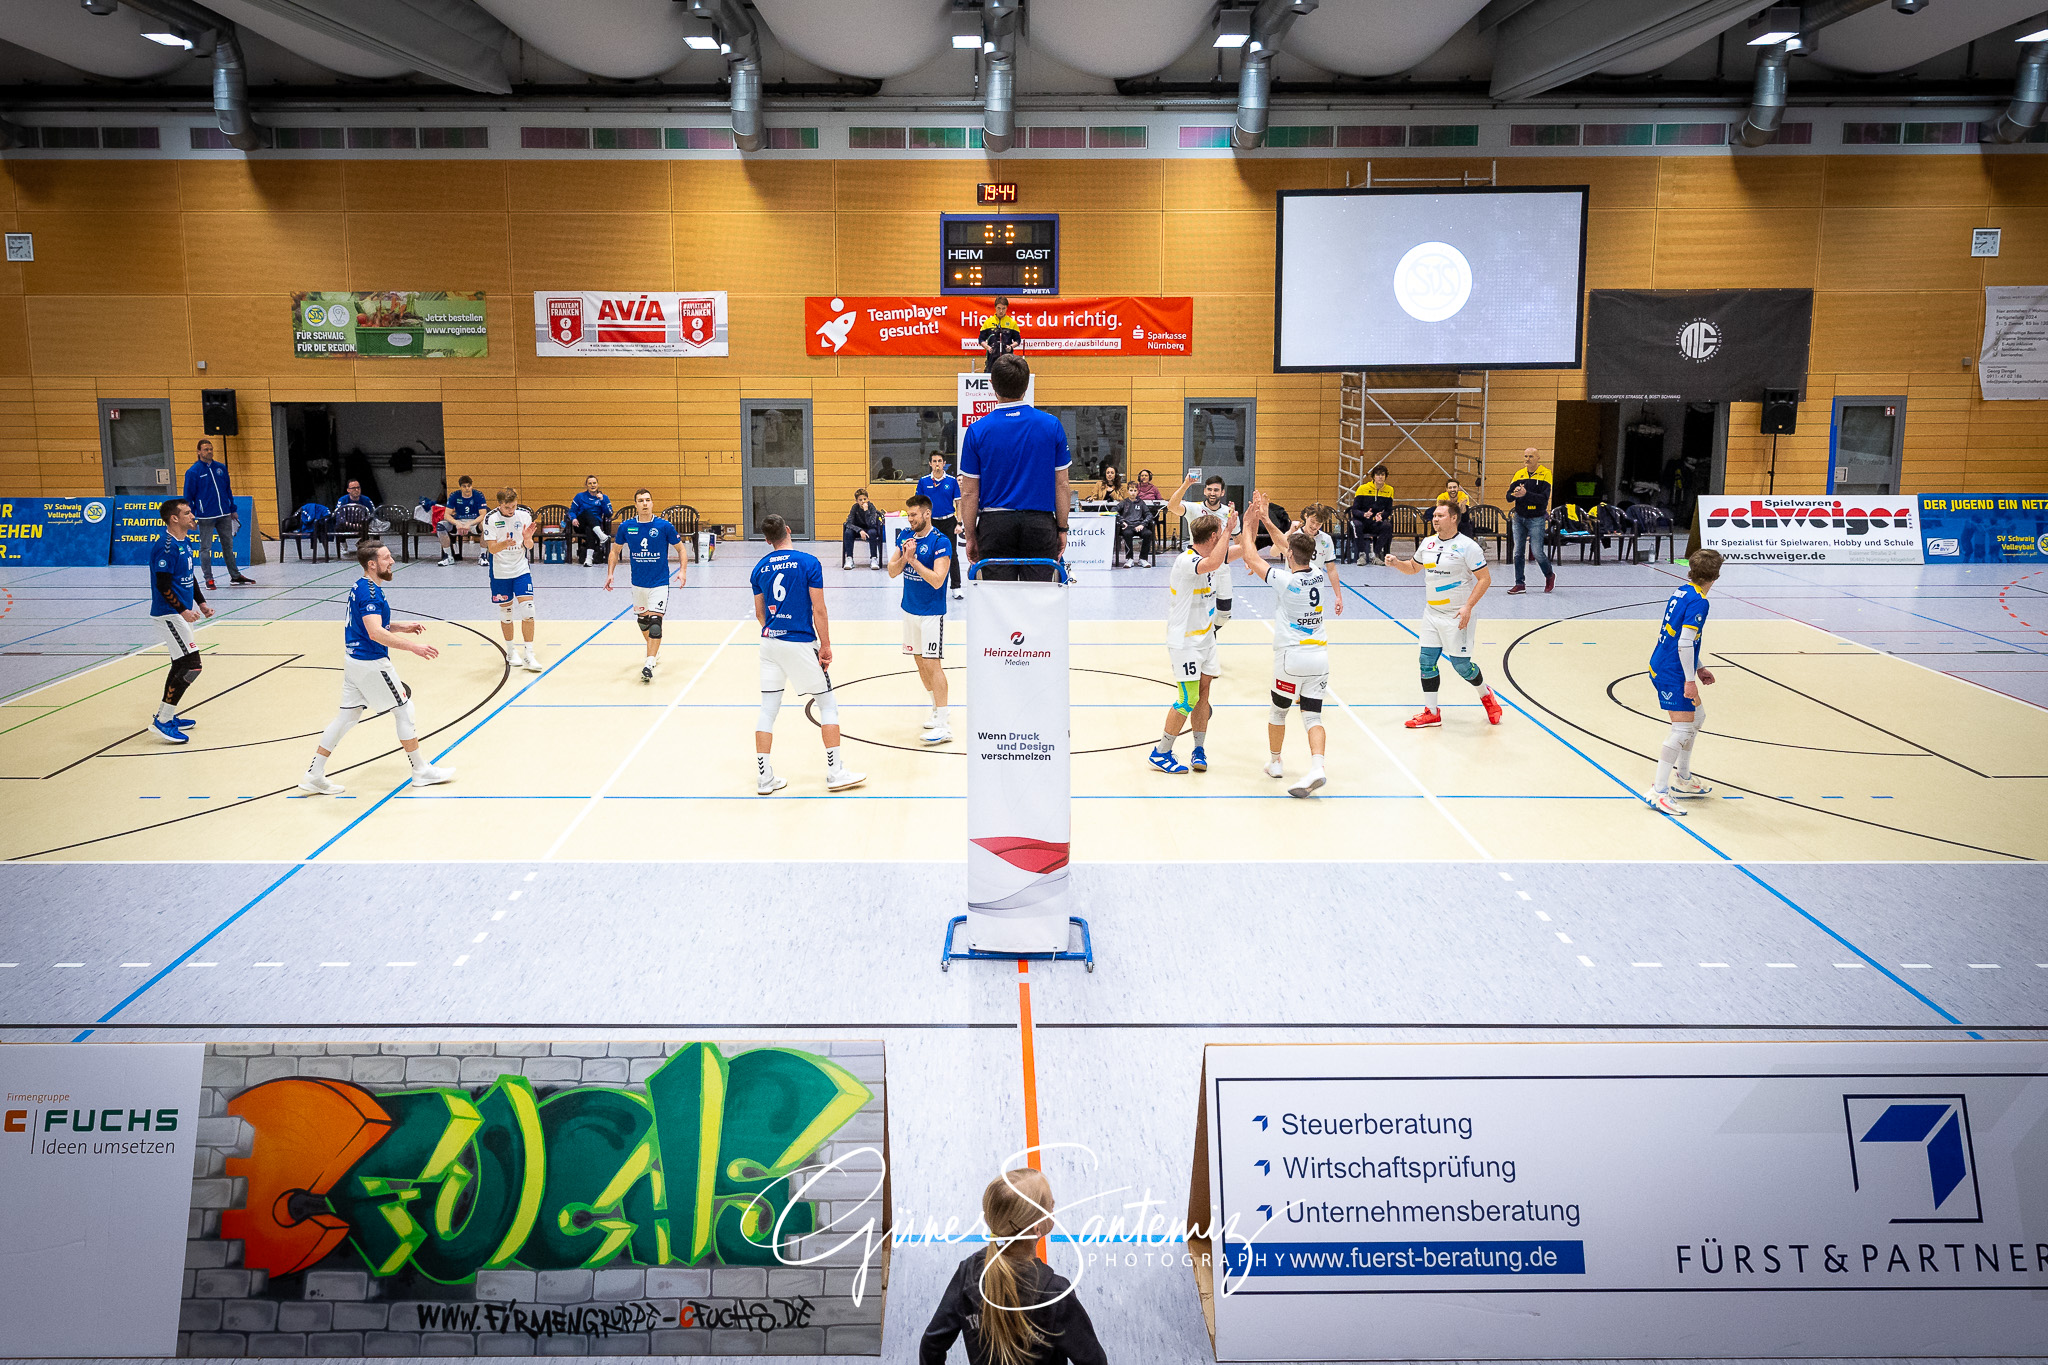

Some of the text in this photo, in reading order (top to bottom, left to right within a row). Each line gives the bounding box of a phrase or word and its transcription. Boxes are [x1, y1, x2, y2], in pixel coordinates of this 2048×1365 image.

[984, 184, 1015, 201] 19:44
[948, 249, 1051, 260] HEIM GAST
[425, 313, 484, 323] Jetzt bestellen
[551, 308, 580, 317] FRANKEN
[682, 308, 712, 317] FRANKEN
[867, 305, 948, 323] Teamplayer
[961, 311, 989, 328] Hie
[1037, 311, 1059, 328] du
[1063, 311, 1123, 331] richtig.
[296, 330, 346, 341] FÜR SCHWAIG.
[425, 325, 487, 336] www.regineo.de
[879, 321, 940, 342] gesucht!
[1147, 331, 1188, 341] Sparkasse
[297, 343, 357, 353] FÜR DIE REGION.
[1147, 341, 1185, 352] Nürnberg
[965, 378, 992, 390] ME
[43, 503, 82, 511] SV Schwaig
[148, 502, 163, 510] EM
[1764, 499, 1832, 508] Spielwaren
[1923, 499, 1947, 510] DER
[1950, 499, 1994, 512] JUGEND
[1998, 499, 2018, 510] EIN
[47, 511, 81, 519] Volleyball
[1706, 500, 1910, 536] schweiger
[640, 537, 648, 550] 4
[1707, 538, 1718, 547] Ihr
[1721, 538, 1763, 548] Spezialist
[1765, 538, 1778, 547] für
[1833, 538, 1862, 548] Hobby
[1864, 538, 1881, 547] und
[1883, 538, 1914, 547] Schule
[2008, 535, 2035, 543] Schwaig
[2001, 543, 2035, 551] Volleyball
[1436, 552, 1442, 565] 1
[772, 561, 798, 571] VOLLEYS
[772, 572, 787, 602] 6
[1309, 586, 1320, 608] 9
[928, 642, 938, 652] 10
[983, 647, 1051, 658] Heinzelmann
[1004, 658, 1030, 667] Medien
[1182, 661, 1197, 676] 15
[978, 731, 1040, 741] Wenn Druck
[996, 742, 1055, 753] und Design
[981, 752, 1051, 761] verschmelzen
[6, 1092, 70, 1104] Firmengruppe
[44, 1108, 179, 1132] FUCHS
[1281, 1112, 1473, 1140] Steuerberatung
[41, 1138, 175, 1155] Ideen umsetzen
[1282, 1155, 1517, 1184] Wirtschaftsprüfung
[1285, 1200, 1581, 1227] Unternehmensberatung
[1290, 1246, 1558, 1272] www.fuerst-beratung.de
[1676, 1237, 1810, 1274] FÜRST
